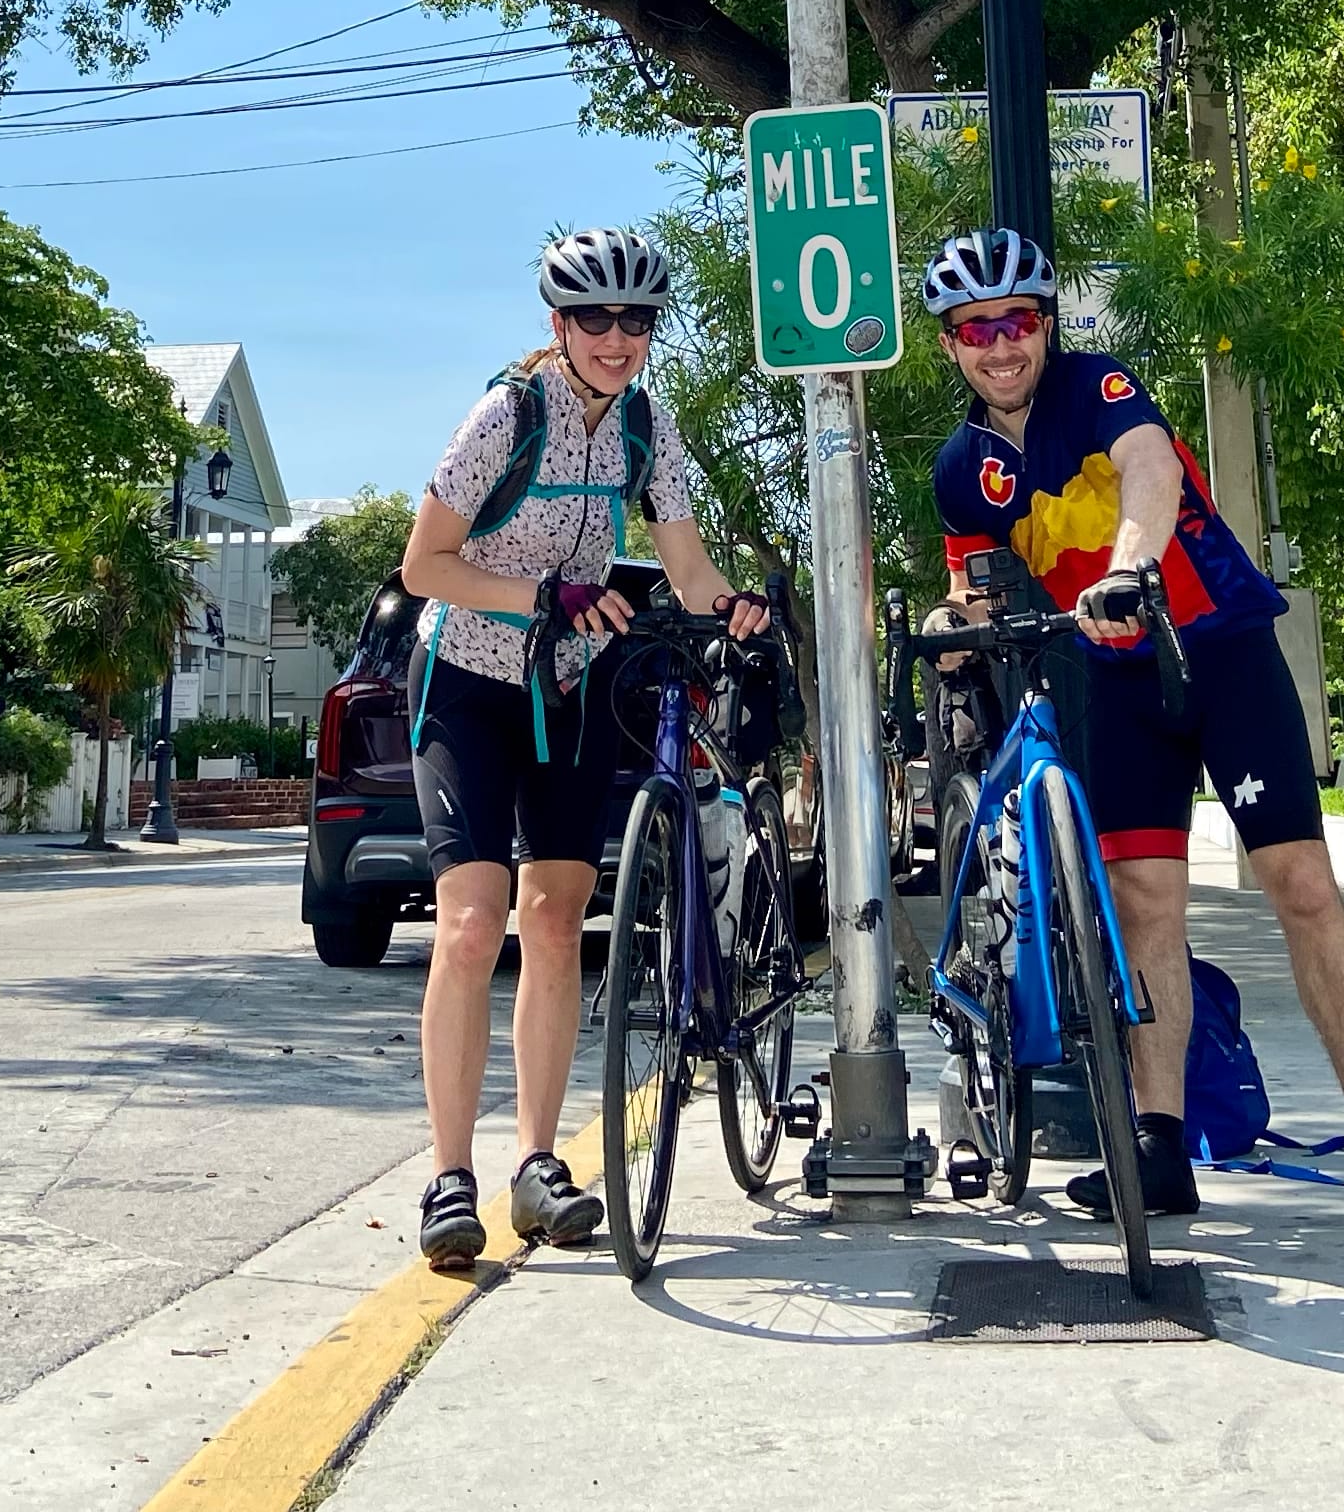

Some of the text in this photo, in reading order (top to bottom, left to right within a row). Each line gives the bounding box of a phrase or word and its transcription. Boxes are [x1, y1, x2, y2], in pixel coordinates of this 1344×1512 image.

[1112, 136, 1134, 148] For
[762, 143, 879, 213] MILE
[797, 233, 852, 330] 0
